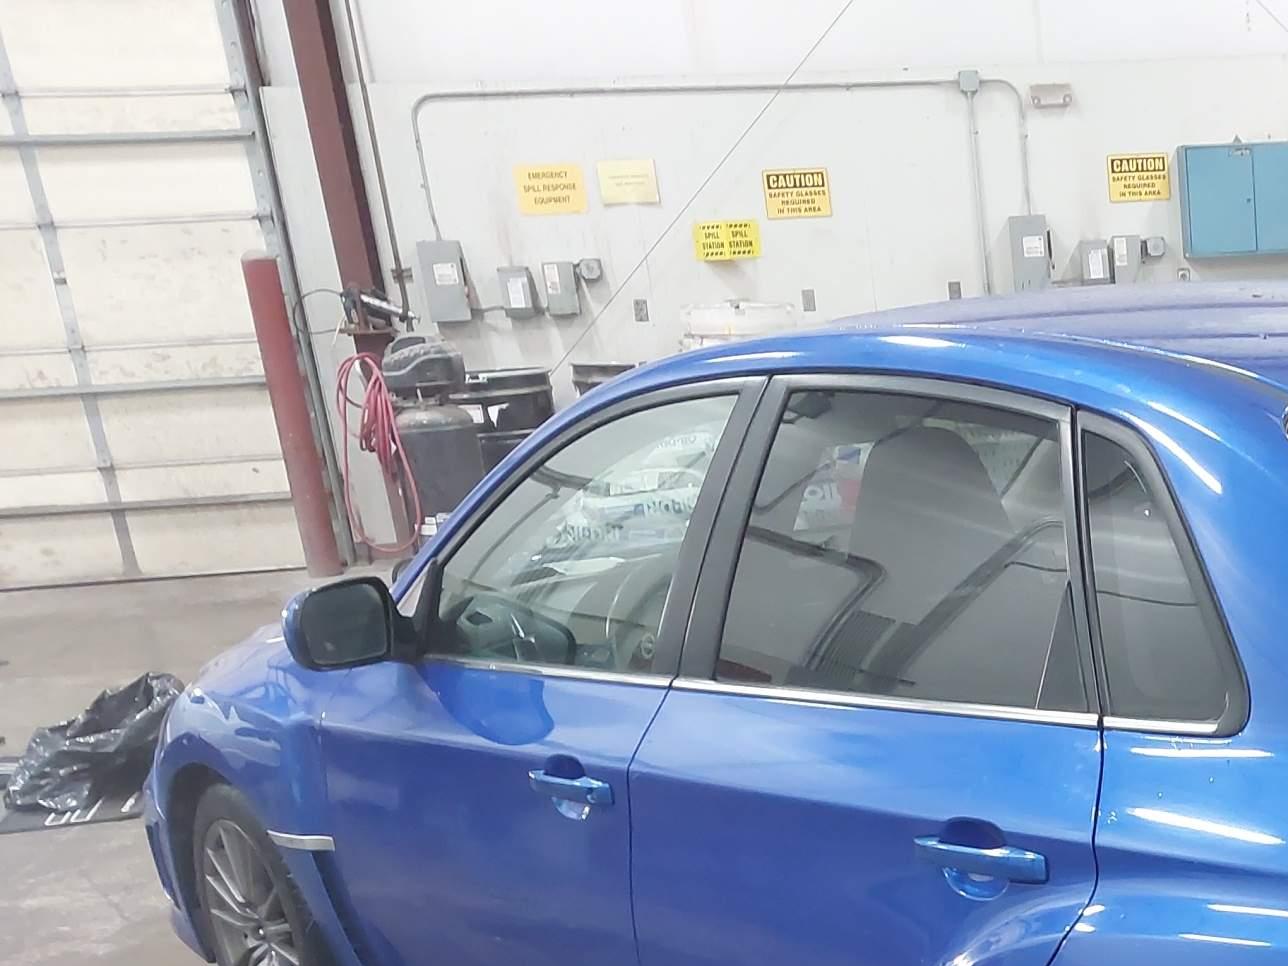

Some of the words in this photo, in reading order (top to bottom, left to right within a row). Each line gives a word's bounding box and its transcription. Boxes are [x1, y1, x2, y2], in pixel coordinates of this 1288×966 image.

[1112, 158, 1164, 172] CAUTION
[527, 170, 568, 180] EMERGENCY
[1112, 174, 1136, 182] SAFETY
[1138, 173, 1167, 181] GLASSES
[769, 173, 823, 189] CAUTION
[523, 184, 542, 193] SPILL
[543, 182, 576, 191] RESPONSE
[1123, 182, 1156, 190] REQUIRED
[768, 190, 794, 199] SAFETY
[796, 189, 826, 197] GLASSES
[781, 198, 816, 206] REQUIRED
[704, 231, 720, 240] SPILL
[731, 230, 748, 239] SPILL
[702, 241, 725, 250] STATION
[729, 239, 753, 249] STATION
